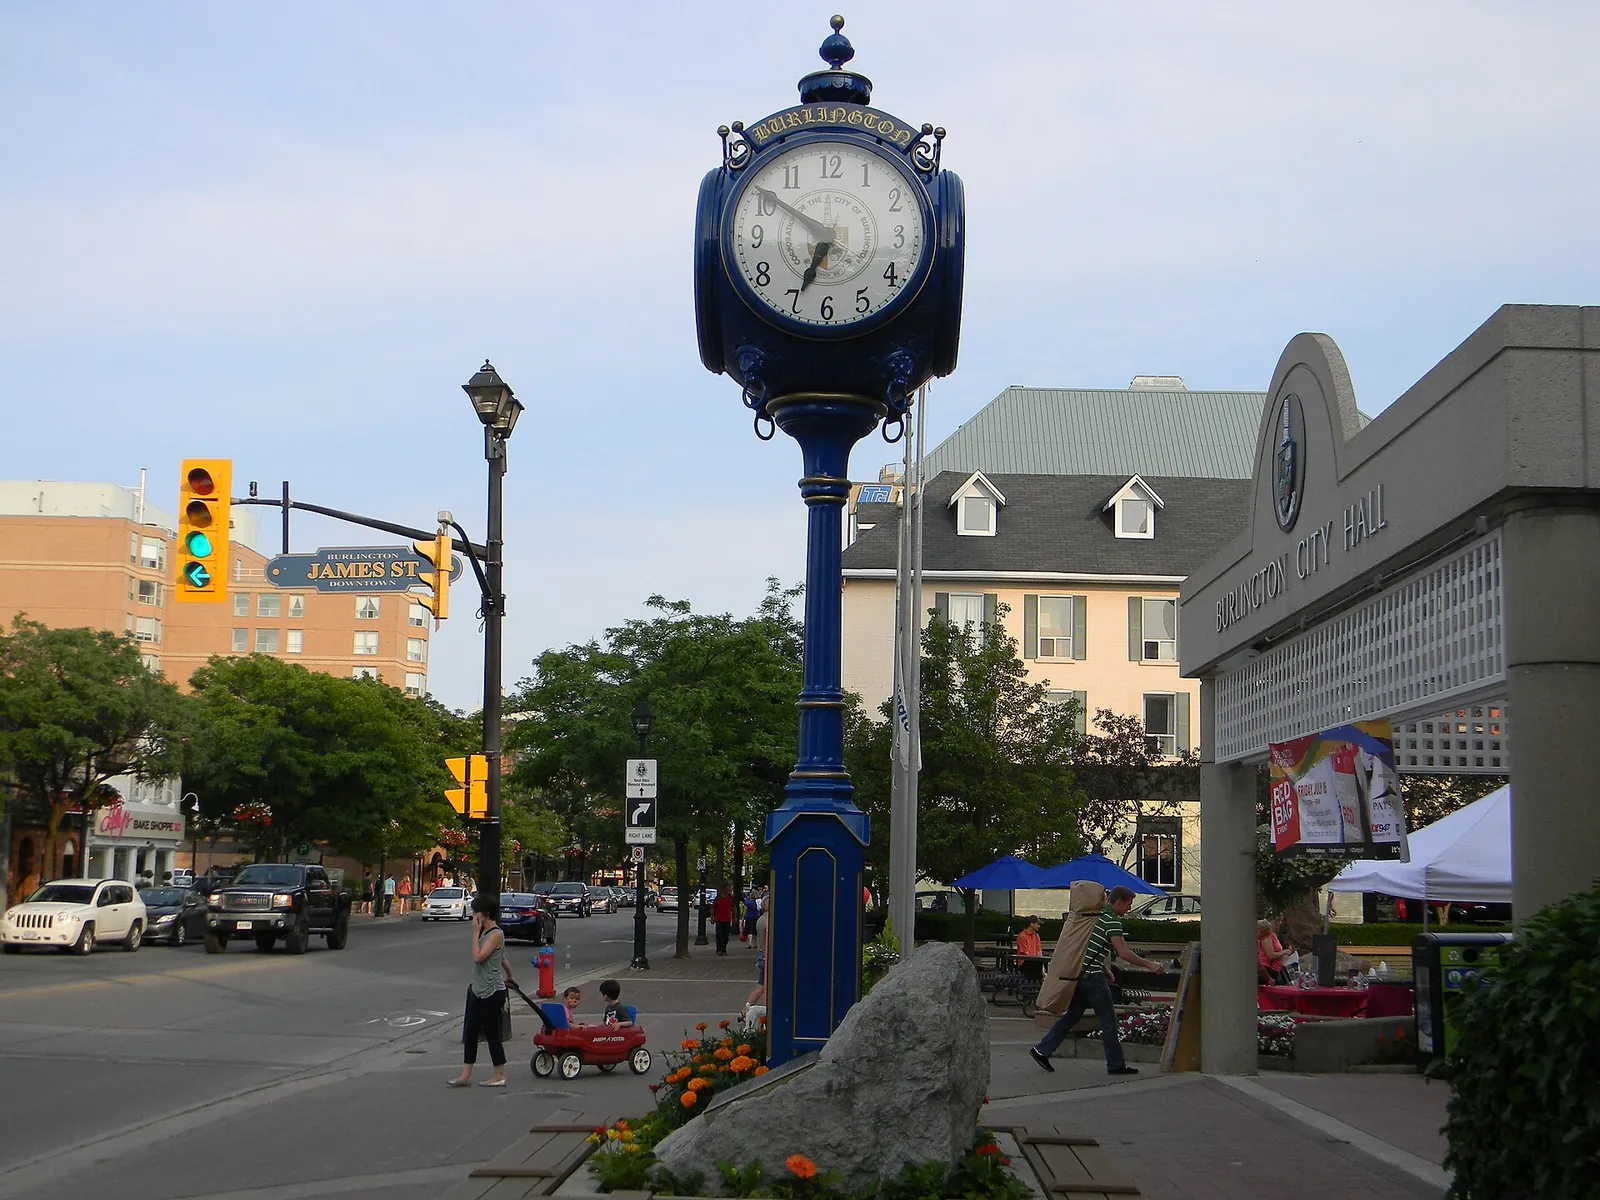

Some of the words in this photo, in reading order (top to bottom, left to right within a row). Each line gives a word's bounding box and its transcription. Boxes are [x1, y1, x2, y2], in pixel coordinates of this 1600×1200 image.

[753, 106, 911, 146] BURLINGTON
[782, 164, 801, 190] 11
[819, 155, 844, 179] 12
[861, 163, 871, 188] 1
[888, 187, 902, 213] 2
[751, 224, 764, 249] 9
[785, 217, 801, 266] CORPORATIO
[807, 196, 822, 206] THE
[834, 196, 851, 207] CITY
[851, 205, 862, 215] OF
[893, 224, 905, 249] 3
[756, 262, 771, 287] 8
[883, 261, 898, 287] 4
[784, 289, 803, 314] 7
[820, 295, 834, 321] 6
[855, 286, 871, 313] 5
[327, 552, 399, 560] BURLINGTON
[1215, 553, 1289, 633] BURLINGTON
[1296, 521, 1333, 580] CITY
[1342, 484, 1388, 552] HALL
[306, 561, 385, 580] JAMES
[389, 561, 420, 578] ST
[1273, 781, 1291, 806] RED
[1275, 800, 1293, 825] BAG
[134, 820, 149, 830] BAKE
[150, 821, 173, 832] SHOPPE
